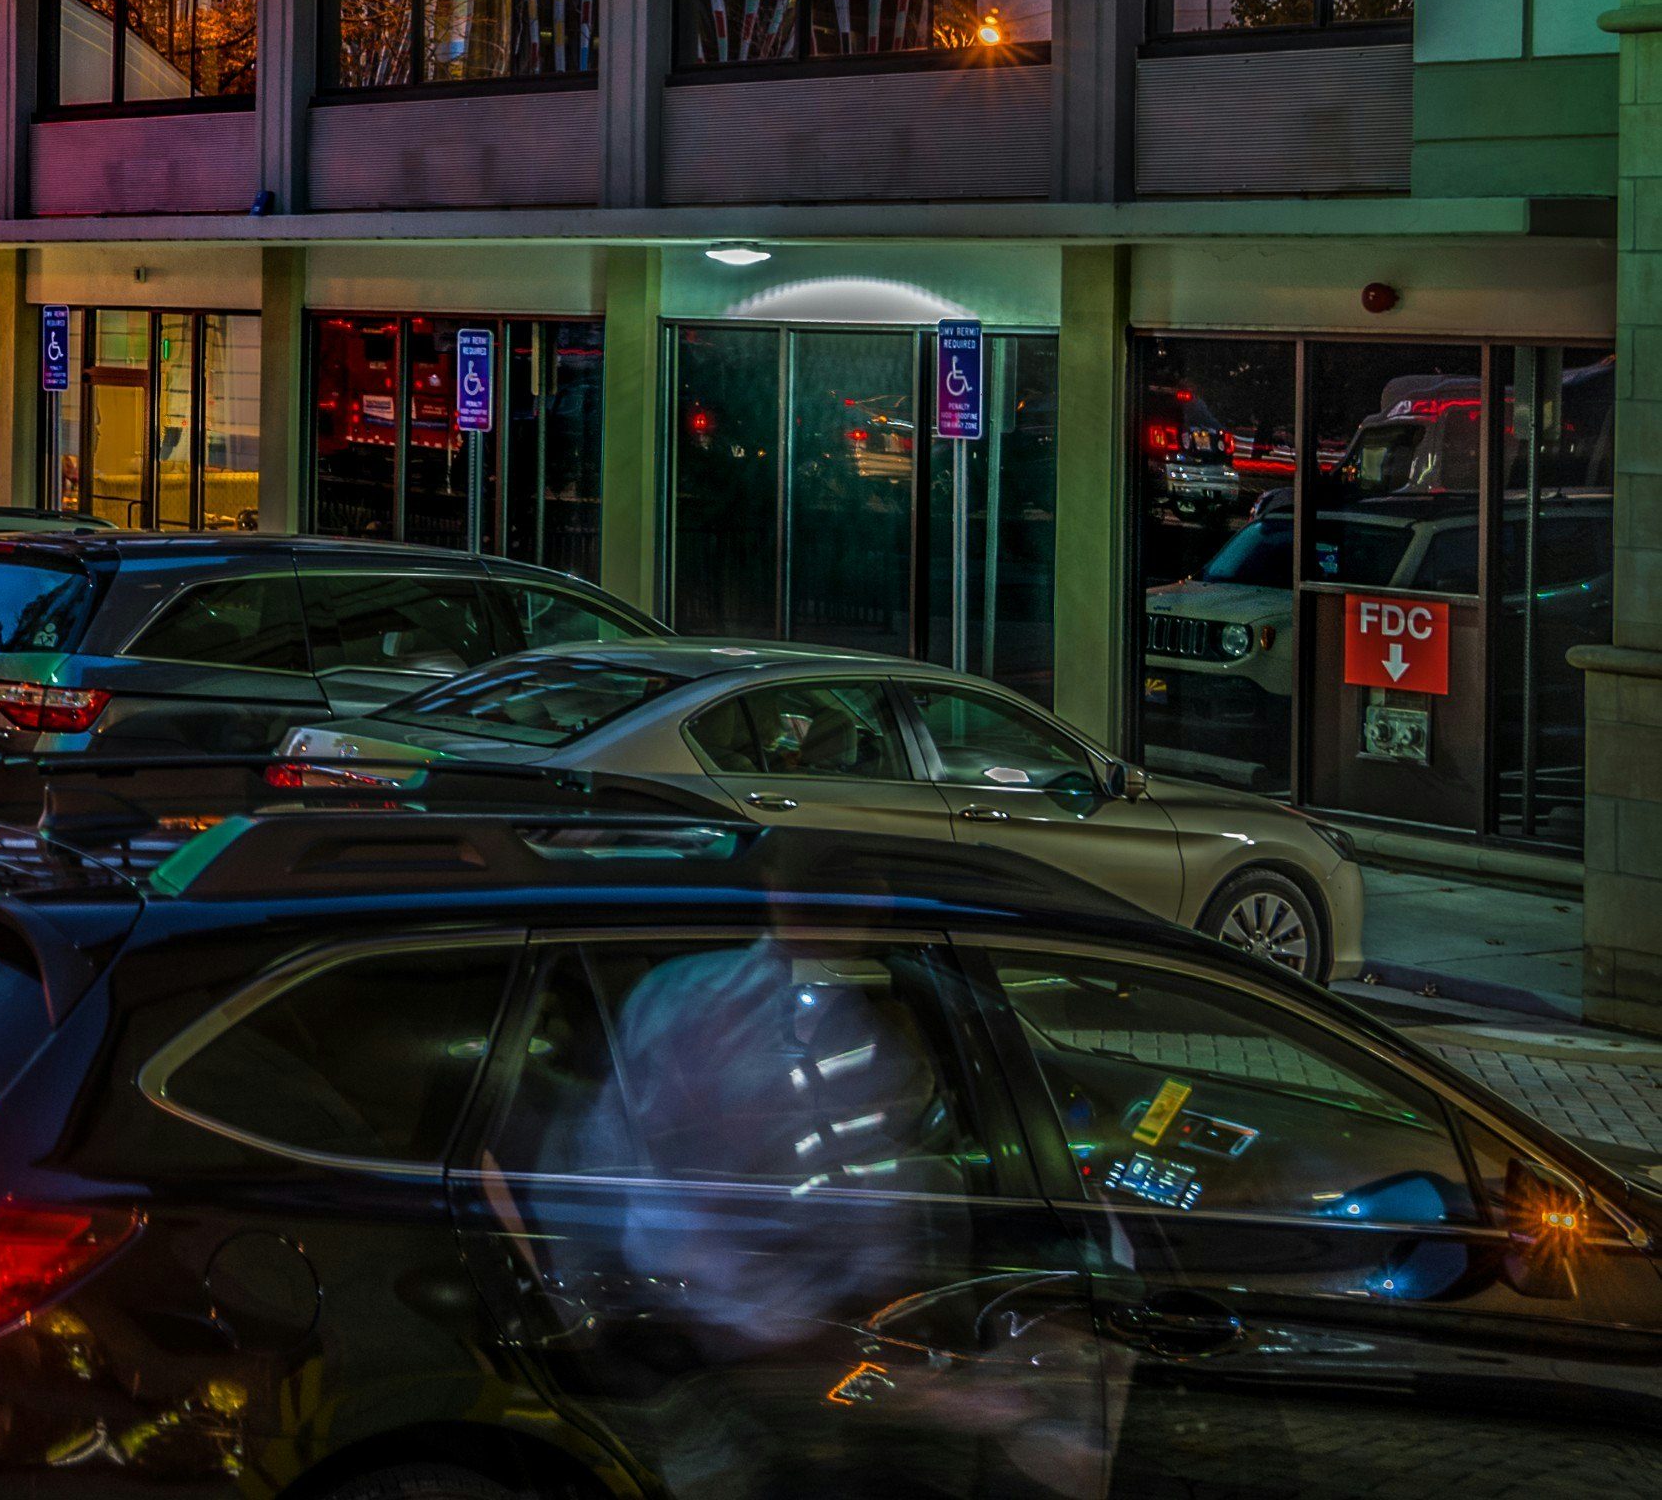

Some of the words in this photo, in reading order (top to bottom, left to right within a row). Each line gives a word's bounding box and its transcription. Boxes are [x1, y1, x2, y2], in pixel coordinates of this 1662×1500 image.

[943, 339, 976, 349] REQUIRED
[948, 402, 970, 411] PENALTY
[1360, 601, 1432, 639] FDC
